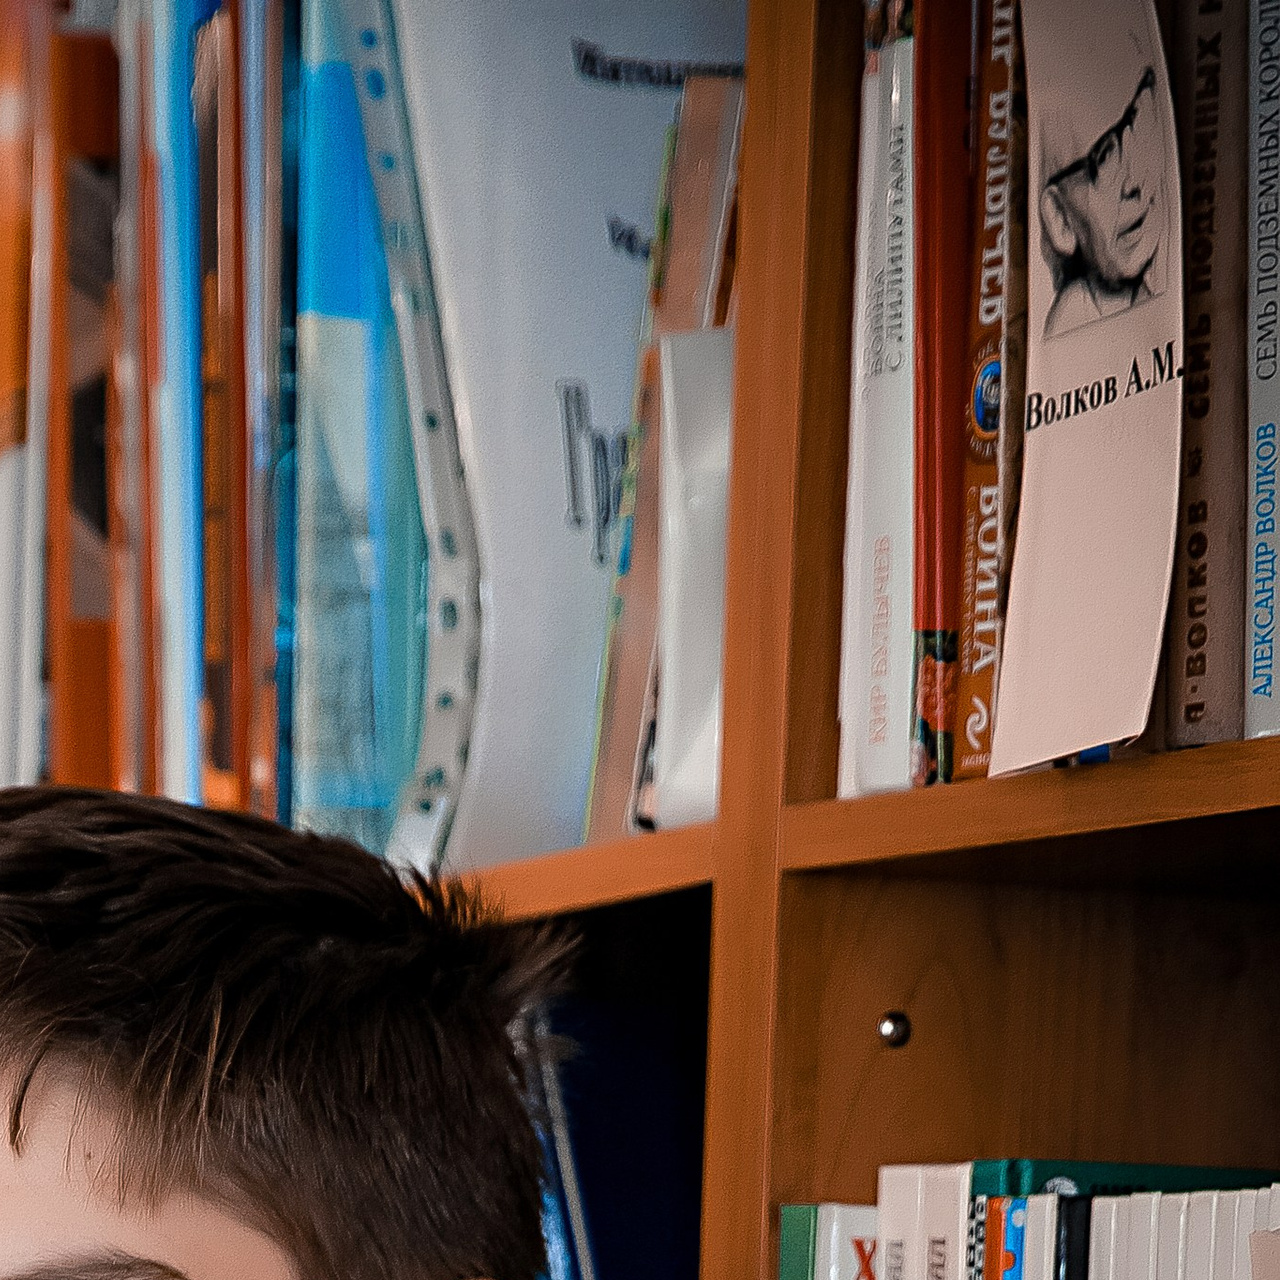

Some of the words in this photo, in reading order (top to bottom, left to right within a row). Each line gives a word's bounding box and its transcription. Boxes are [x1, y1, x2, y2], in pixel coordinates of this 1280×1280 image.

[1257, 0, 1280, 108] КОРОЛ
[1189, 32, 1221, 294] ПОДЗЕМНЫХ
[1256, 111, 1280, 296] ПОДЗЕМНЫХ
[1025, 375, 1118, 433] Волков
[1123, 339, 1185, 399] А.М.
[1187, 312, 1212, 421] СЕМЬ
[1255, 299, 1278, 381] СЕМЬ
[1255, 422, 1278, 534] ВОЛКОВ
[1185, 500, 1209, 678] ВОЛКОВ
[1252, 541, 1276, 699] АЛЕКСАНДР
